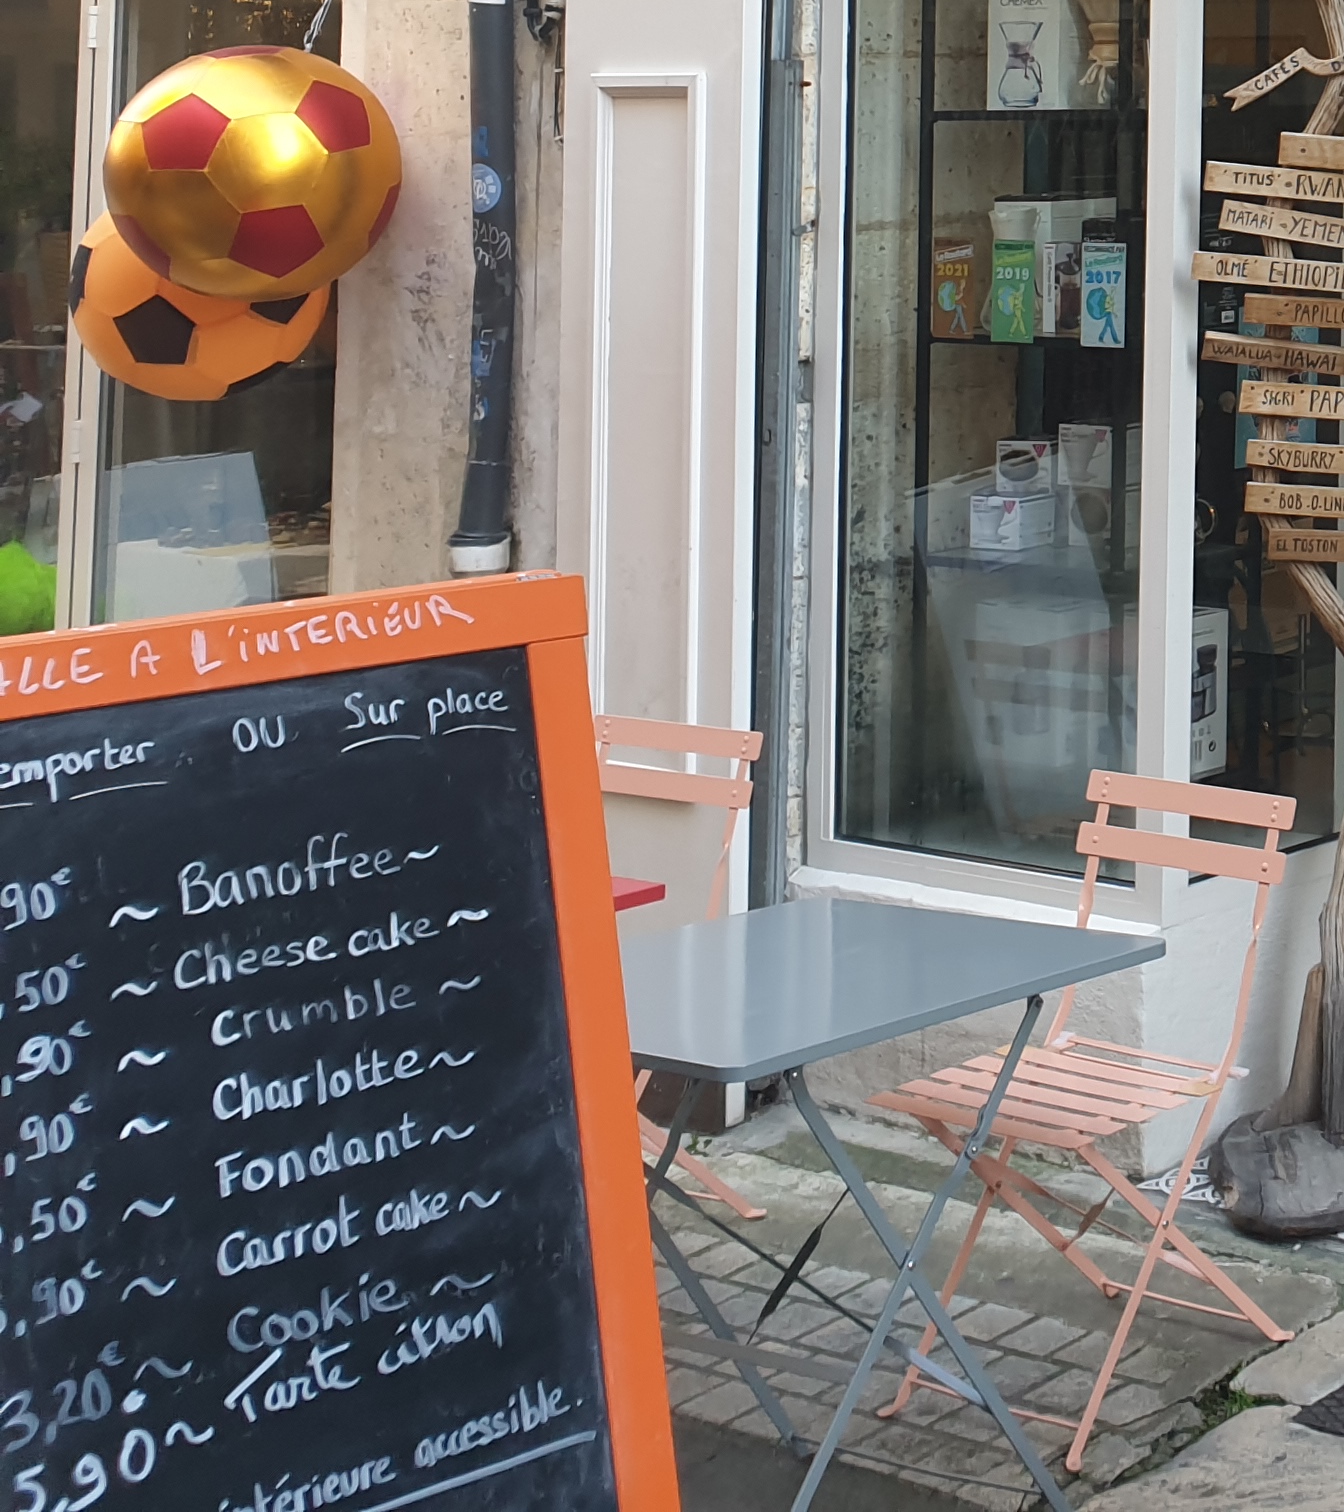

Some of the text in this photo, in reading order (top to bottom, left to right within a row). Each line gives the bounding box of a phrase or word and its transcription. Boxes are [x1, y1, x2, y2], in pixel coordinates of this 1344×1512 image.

[937, 263, 969, 277] 2021
[996, 267, 1030, 281] 2019
[1085, 270, 1122, 285] 2017
[130, 640, 161, 678] A
[232, 715, 286, 753] OU
[343, 692, 406, 730] Sur
[427, 687, 509, 735] place
[179, 832, 403, 916] Banoffee
[173, 907, 440, 990] Cheese cake
[210, 977, 417, 1048] Crumble
[212, 1041, 426, 1121] Charlotte
[214, 1111, 422, 1198] Fondant
[217, 1185, 450, 1278] Carrot cake
[226, 1271, 411, 1353] Cookie
[223, 1301, 502, 1423] Tarte citron
